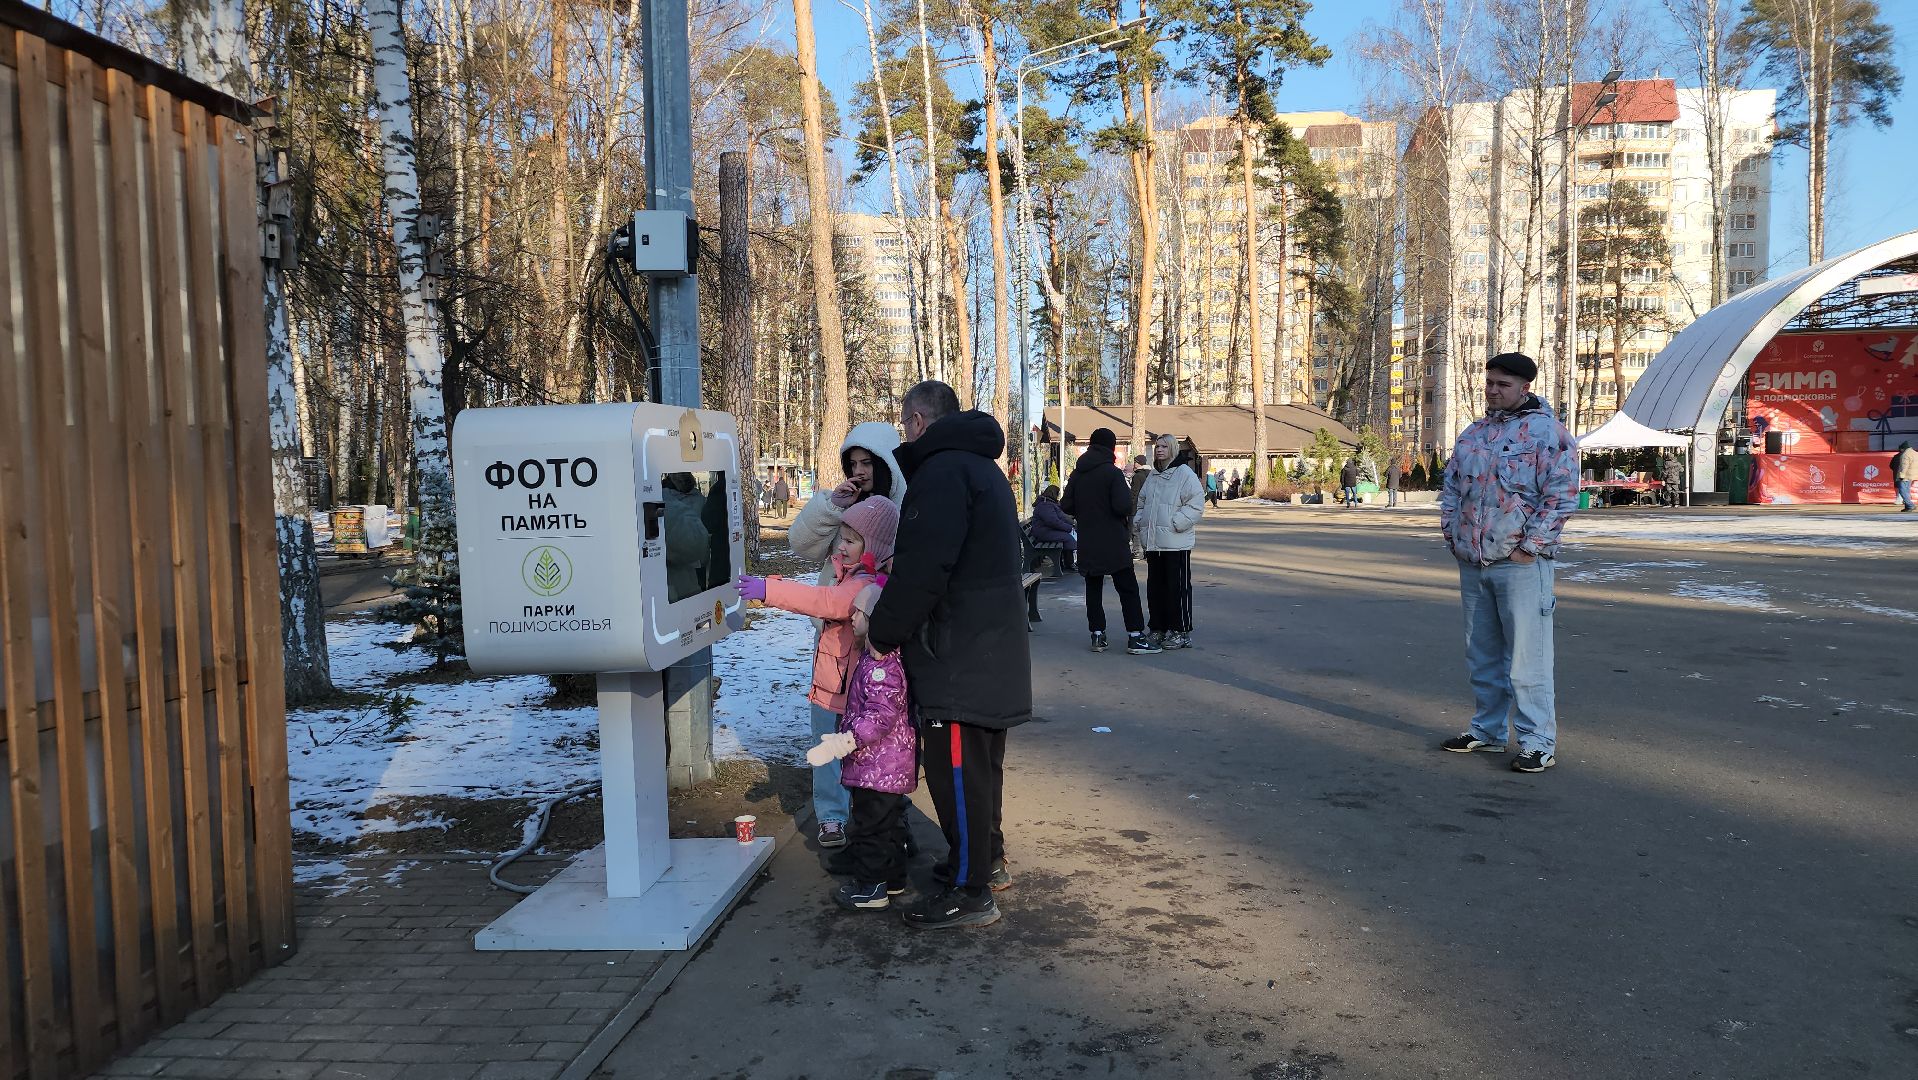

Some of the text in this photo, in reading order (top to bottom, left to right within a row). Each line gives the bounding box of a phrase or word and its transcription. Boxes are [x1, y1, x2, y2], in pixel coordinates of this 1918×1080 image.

[1755, 370, 1837, 390] ЗИМА
[484, 457, 598, 490] ФОТО
[528, 493, 557, 510] НА
[501, 513, 587, 532] ПАМЯТЬ
[523, 604, 575, 618] ПАРКИ
[489, 618, 612, 635] ПОДМОСКОВЬЯ
